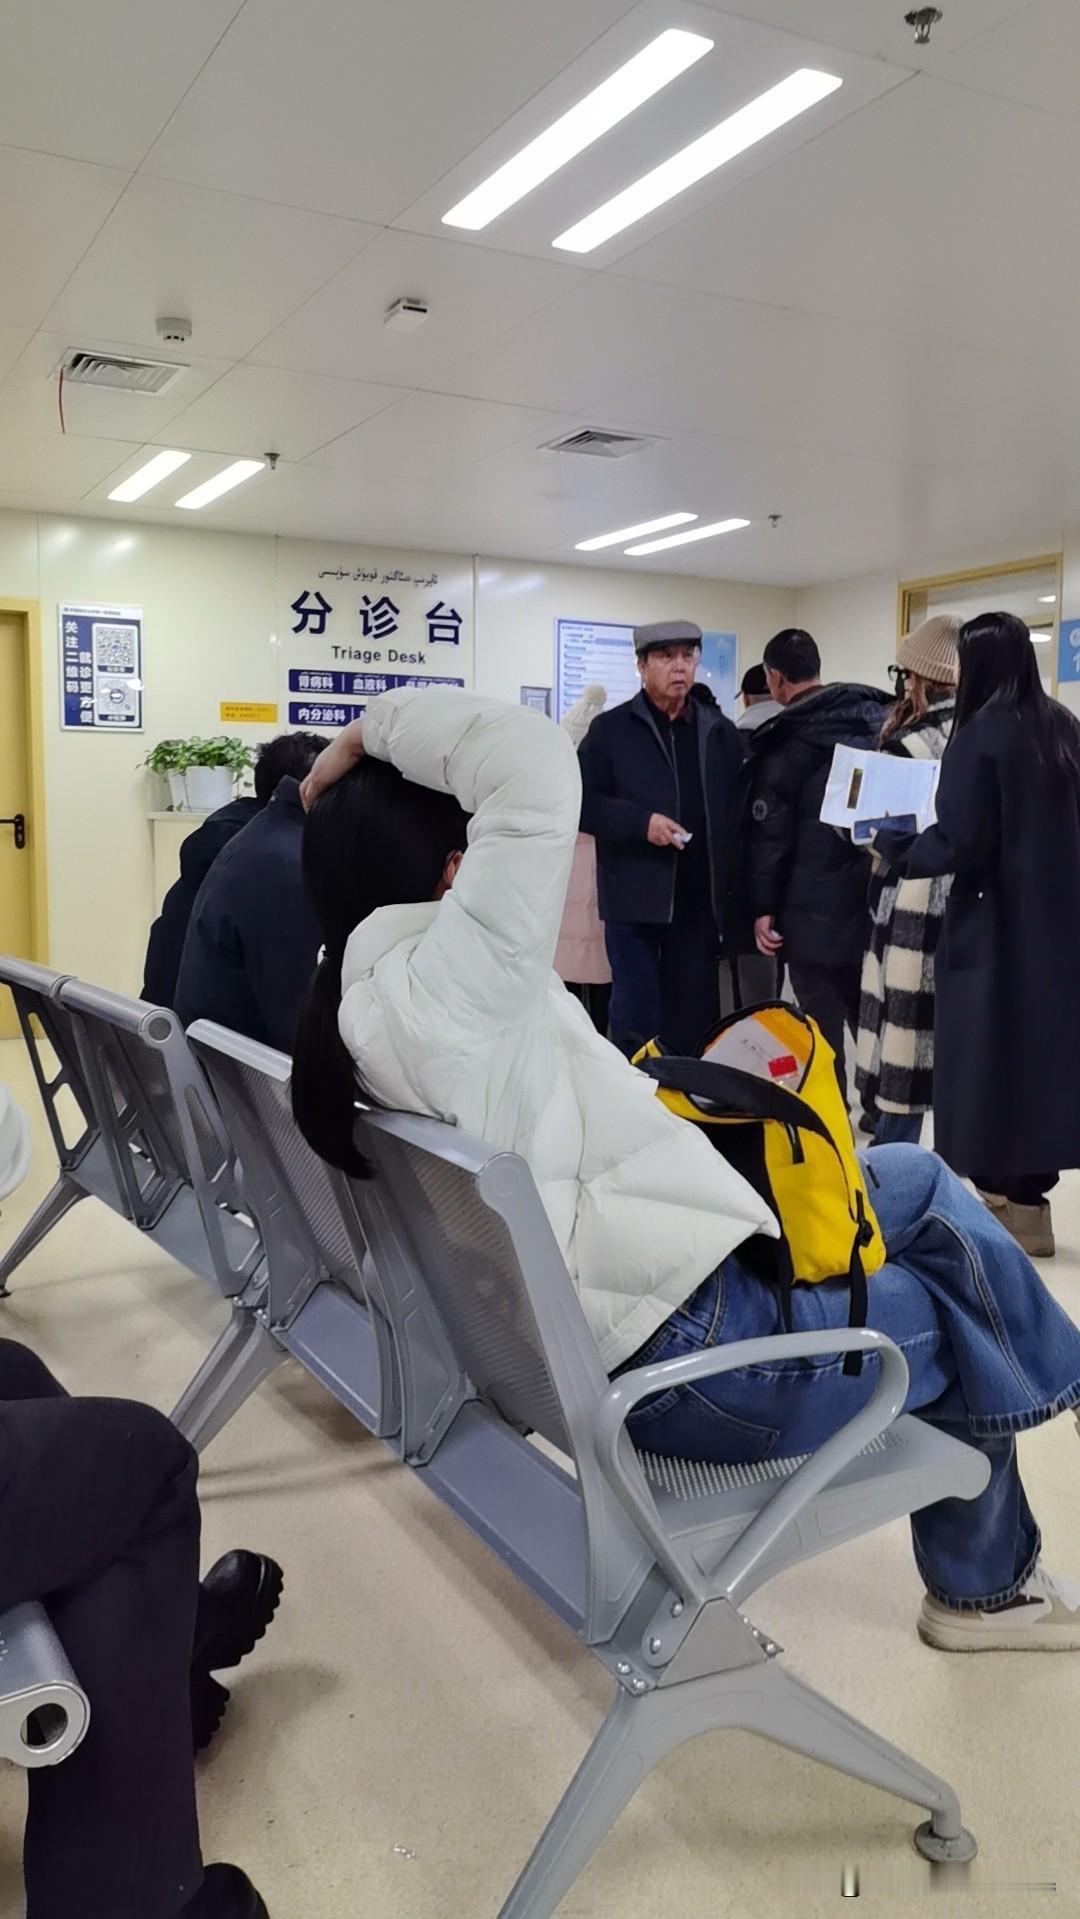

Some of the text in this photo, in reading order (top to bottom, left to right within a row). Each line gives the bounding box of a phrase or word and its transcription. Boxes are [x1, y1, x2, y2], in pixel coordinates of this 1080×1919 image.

[290, 590, 463, 646] 分诊台
[65, 621, 79, 693] 关注二维码
[331, 645, 426, 665] Triage Desk
[79, 651, 93, 723] 就诊更方便
[298, 707, 346, 722] 内分泌科
